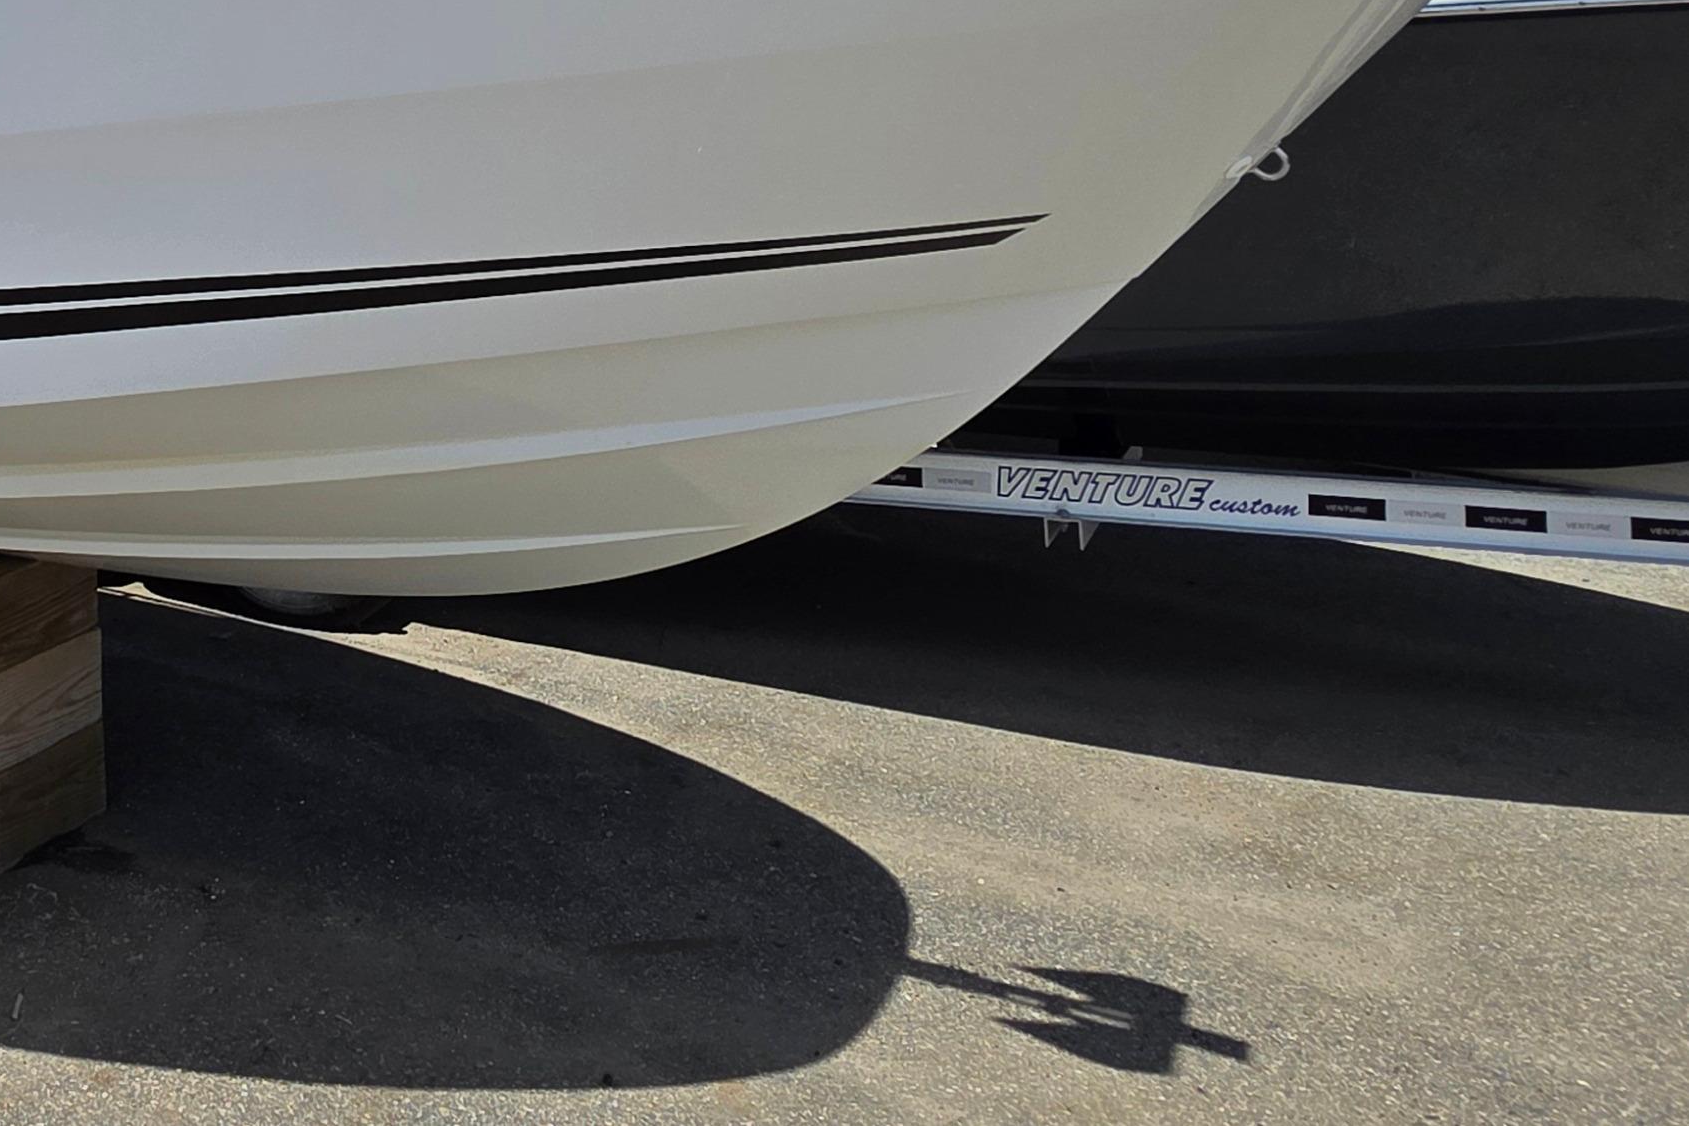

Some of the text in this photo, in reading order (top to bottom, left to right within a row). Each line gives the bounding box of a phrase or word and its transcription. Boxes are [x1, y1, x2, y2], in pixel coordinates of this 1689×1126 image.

[997, 465, 1301, 517] VENTURE custom
[1325, 503, 1368, 515] VENTURE
[1403, 509, 1447, 521] VENTURE
[1483, 515, 1529, 526] VENTURE
[1565, 521, 1612, 532] VENTURE
